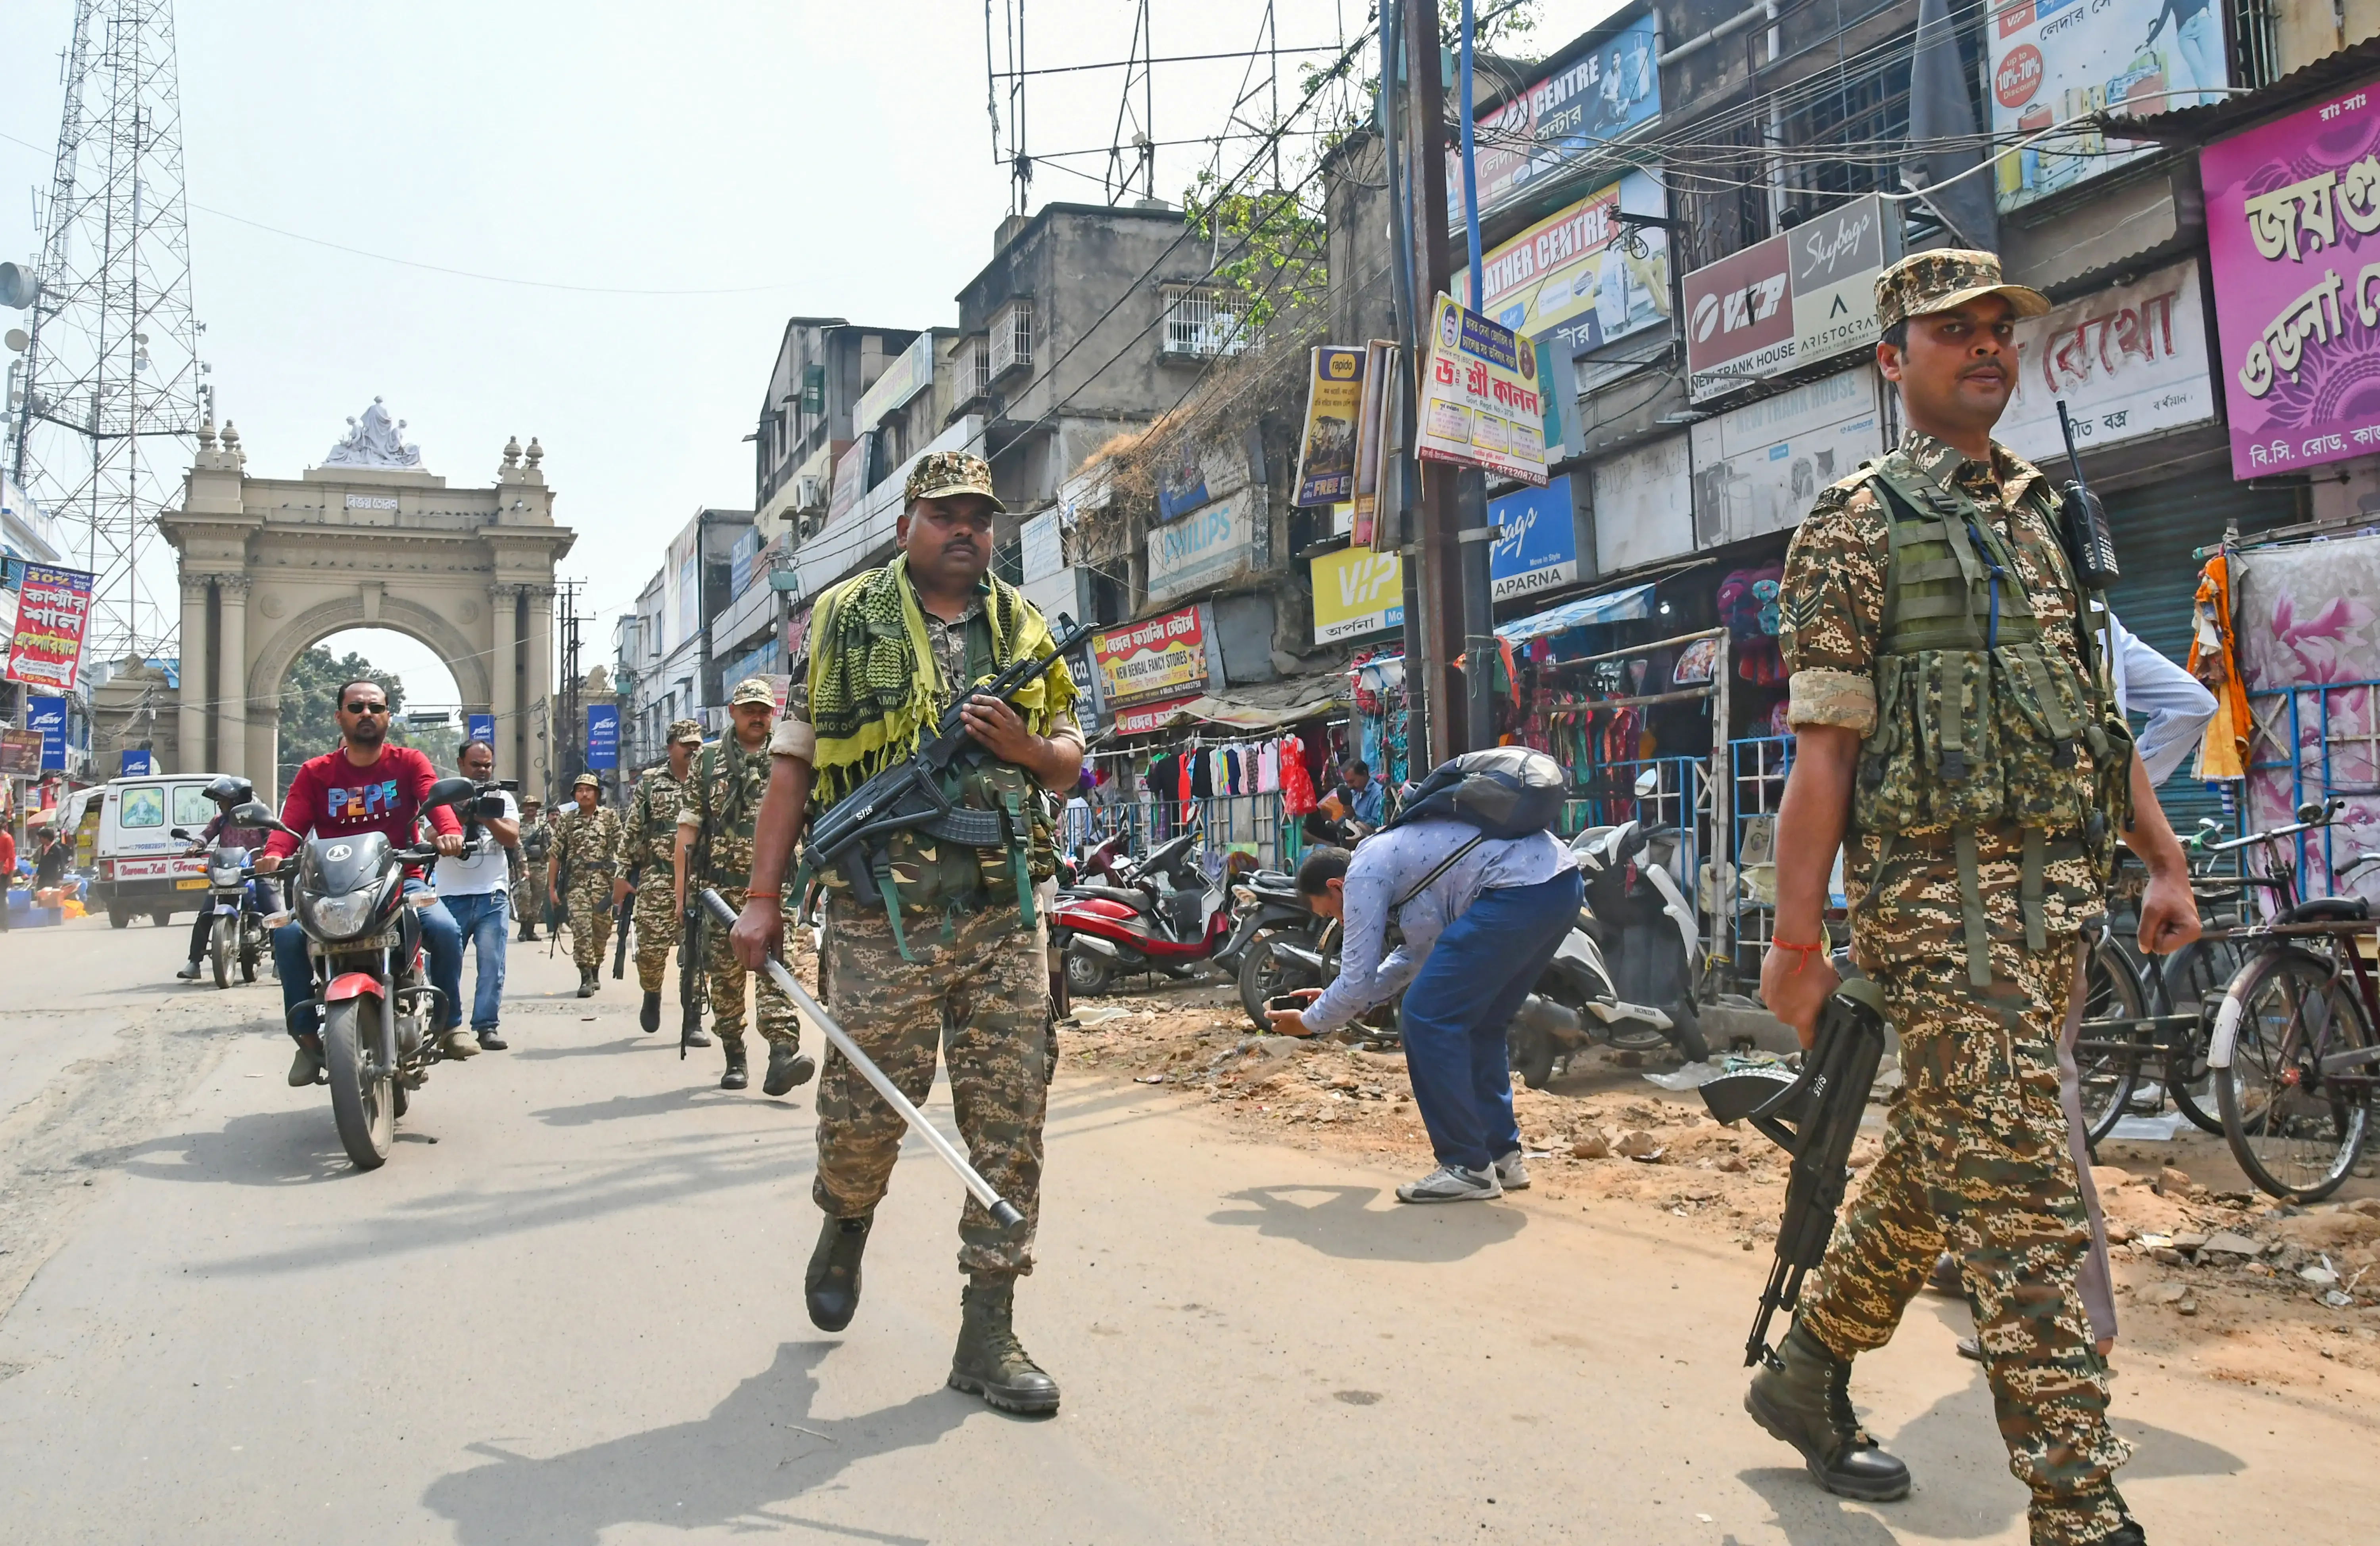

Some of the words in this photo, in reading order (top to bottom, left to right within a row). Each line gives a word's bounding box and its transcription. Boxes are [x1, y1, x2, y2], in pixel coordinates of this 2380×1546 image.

[2007, 10, 2025, 28] VIP
[2040, 6, 2084, 41] লেদার
[2007, 58, 2016, 67] up
[2019, 52, 2027, 60] to
[1997, 55, 2040, 92] 10%-70%
[1532, 54, 1599, 118] CENTRE
[2004, 79, 2037, 100] Discount
[2319, 103, 2340, 121] রাঃ
[2343, 94, 2366, 111] সাঃ
[1482, 245, 1534, 300] ATHER
[1536, 204, 1610, 270] CENTRE
[1802, 214, 1870, 278] Skybags
[1722, 273, 1787, 334] VIP
[1801, 314, 1880, 352] ARISTOCRAT
[2238, 269, 2342, 397] ওড়না
[1812, 345, 1831, 356] UNPACK
[1833, 340, 1847, 349] YOUR
[1848, 333, 1869, 344] DREAMS
[1332, 359, 1352, 372] rapido
[1717, 358, 1754, 381] TRANK
[1756, 343, 1795, 368] HOUSE
[1466, 360, 1489, 398] শ্রী
[1491, 377, 1538, 416] কানন
[1480, 401, 1493, 411] Regd.
[1737, 407, 1763, 434] NEW
[1767, 393, 1808, 423] TRANK
[1812, 372, 1855, 405] HOUSE
[1846, 418, 1873, 432] Aristocrat
[2102, 410, 2129, 430] বস্ত্র
[2249, 444, 2296, 468] বি.সি.
[2303, 433, 2347, 457] রোড,
[1497, 466, 1546, 485] 9732087480
[1313, 478, 1339, 497] FREE
[346, 495, 371, 508] বিজয়
[373, 498, 397, 509] তোরণ
[1165, 507, 1230, 565] PHILIPS
[1530, 558, 1542, 566] Move
[1549, 553, 1561, 562] Style
[27, 571, 72, 587] 30%
[1196, 573, 1212, 587] FANCY
[1338, 550, 1397, 607] VIP
[1495, 568, 1562, 597] APARNA
[23, 587, 88, 611] কাশ্মীর
[22, 605, 83, 634] শাল
[1388, 611, 1403, 622] Mo
[1326, 617, 1375, 636] অর্পনা
[1106, 635, 1131, 654] বেঙ্গল
[1074, 661, 1088, 679] CO.
[1115, 665, 1127, 680] NEW
[1128, 660, 1148, 677] BENGAL
[1149, 656, 1165, 672] FANCY
[1166, 650, 1187, 668] STORES
[1163, 686, 1174, 694] Mob.
[1175, 680, 1201, 692] 9474493758
[31, 713, 63, 725] JSW
[592, 718, 616, 731] JSW
[1127, 714, 1152, 731] বেঙ্গল
[472, 725, 492, 735] JSW
[125, 762, 148, 772] JSW
[328, 780, 401, 817] PEPE
[340, 811, 391, 824] JEANS
[856, 805, 873, 820] S/16
[121, 864, 148, 876] Baroma
[150, 863, 167, 874] Kali
[1635, 1007, 1656, 1017] HONDA
